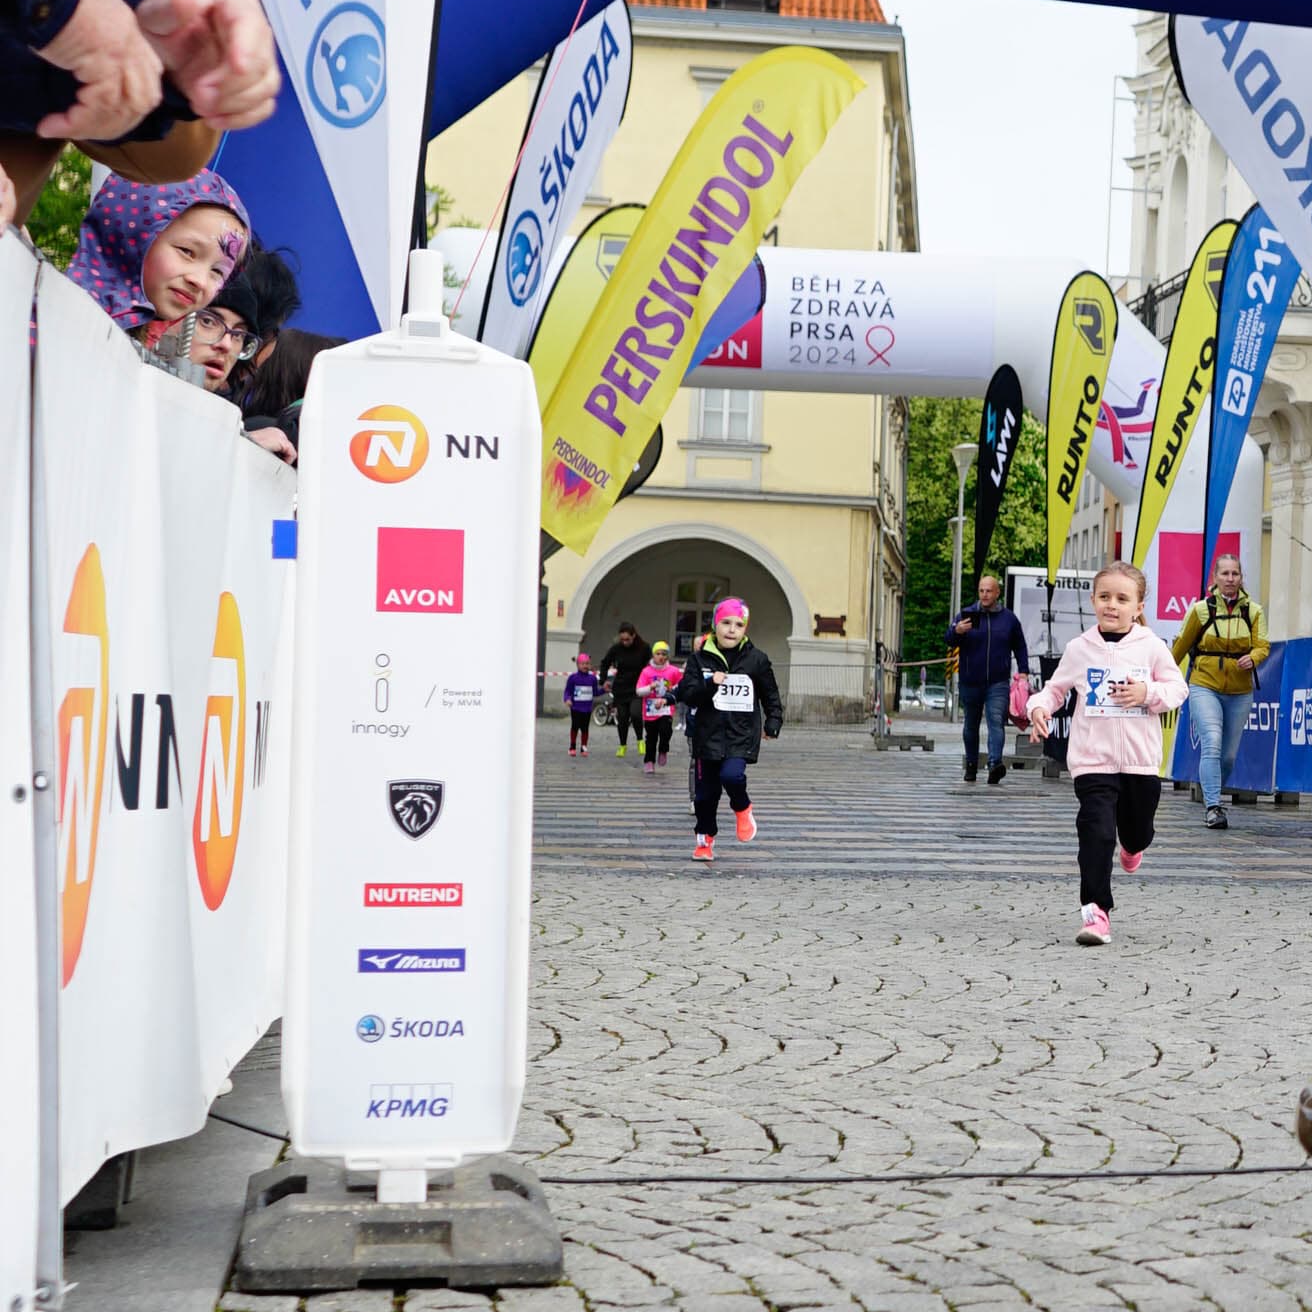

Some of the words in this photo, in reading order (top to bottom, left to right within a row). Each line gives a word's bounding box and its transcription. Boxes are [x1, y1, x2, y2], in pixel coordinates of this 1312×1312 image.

[540, 21, 620, 225] ŠKODA
[583, 113, 795, 438] PERSKINDOL
[1247, 226, 1286, 305] 211
[791, 275, 841, 294] BĚH
[854, 279, 886, 295] ZA
[790, 297, 896, 320] ZDRAVÁ
[790, 321, 855, 342] PRSA
[789, 344, 857, 366] 2024
[1154, 336, 1217, 489] RUNTO
[446, 434, 499, 460] NN
[1057, 375, 1100, 505] RUNTO
[552, 436, 612, 490] PERSKINDOL
[384, 589, 454, 607] AVON
[443, 688, 482, 698] Powered
[721, 684, 750, 697] 3173
[443, 698, 454, 709] by
[457, 698, 481, 707] MVM
[352, 720, 411, 739] innogy
[391, 783, 441, 792] PEUGEOT
[368, 887, 460, 903] NUTREND
[389, 1017, 465, 1038] ŠKODA
[366, 1097, 450, 1119] KPMG
